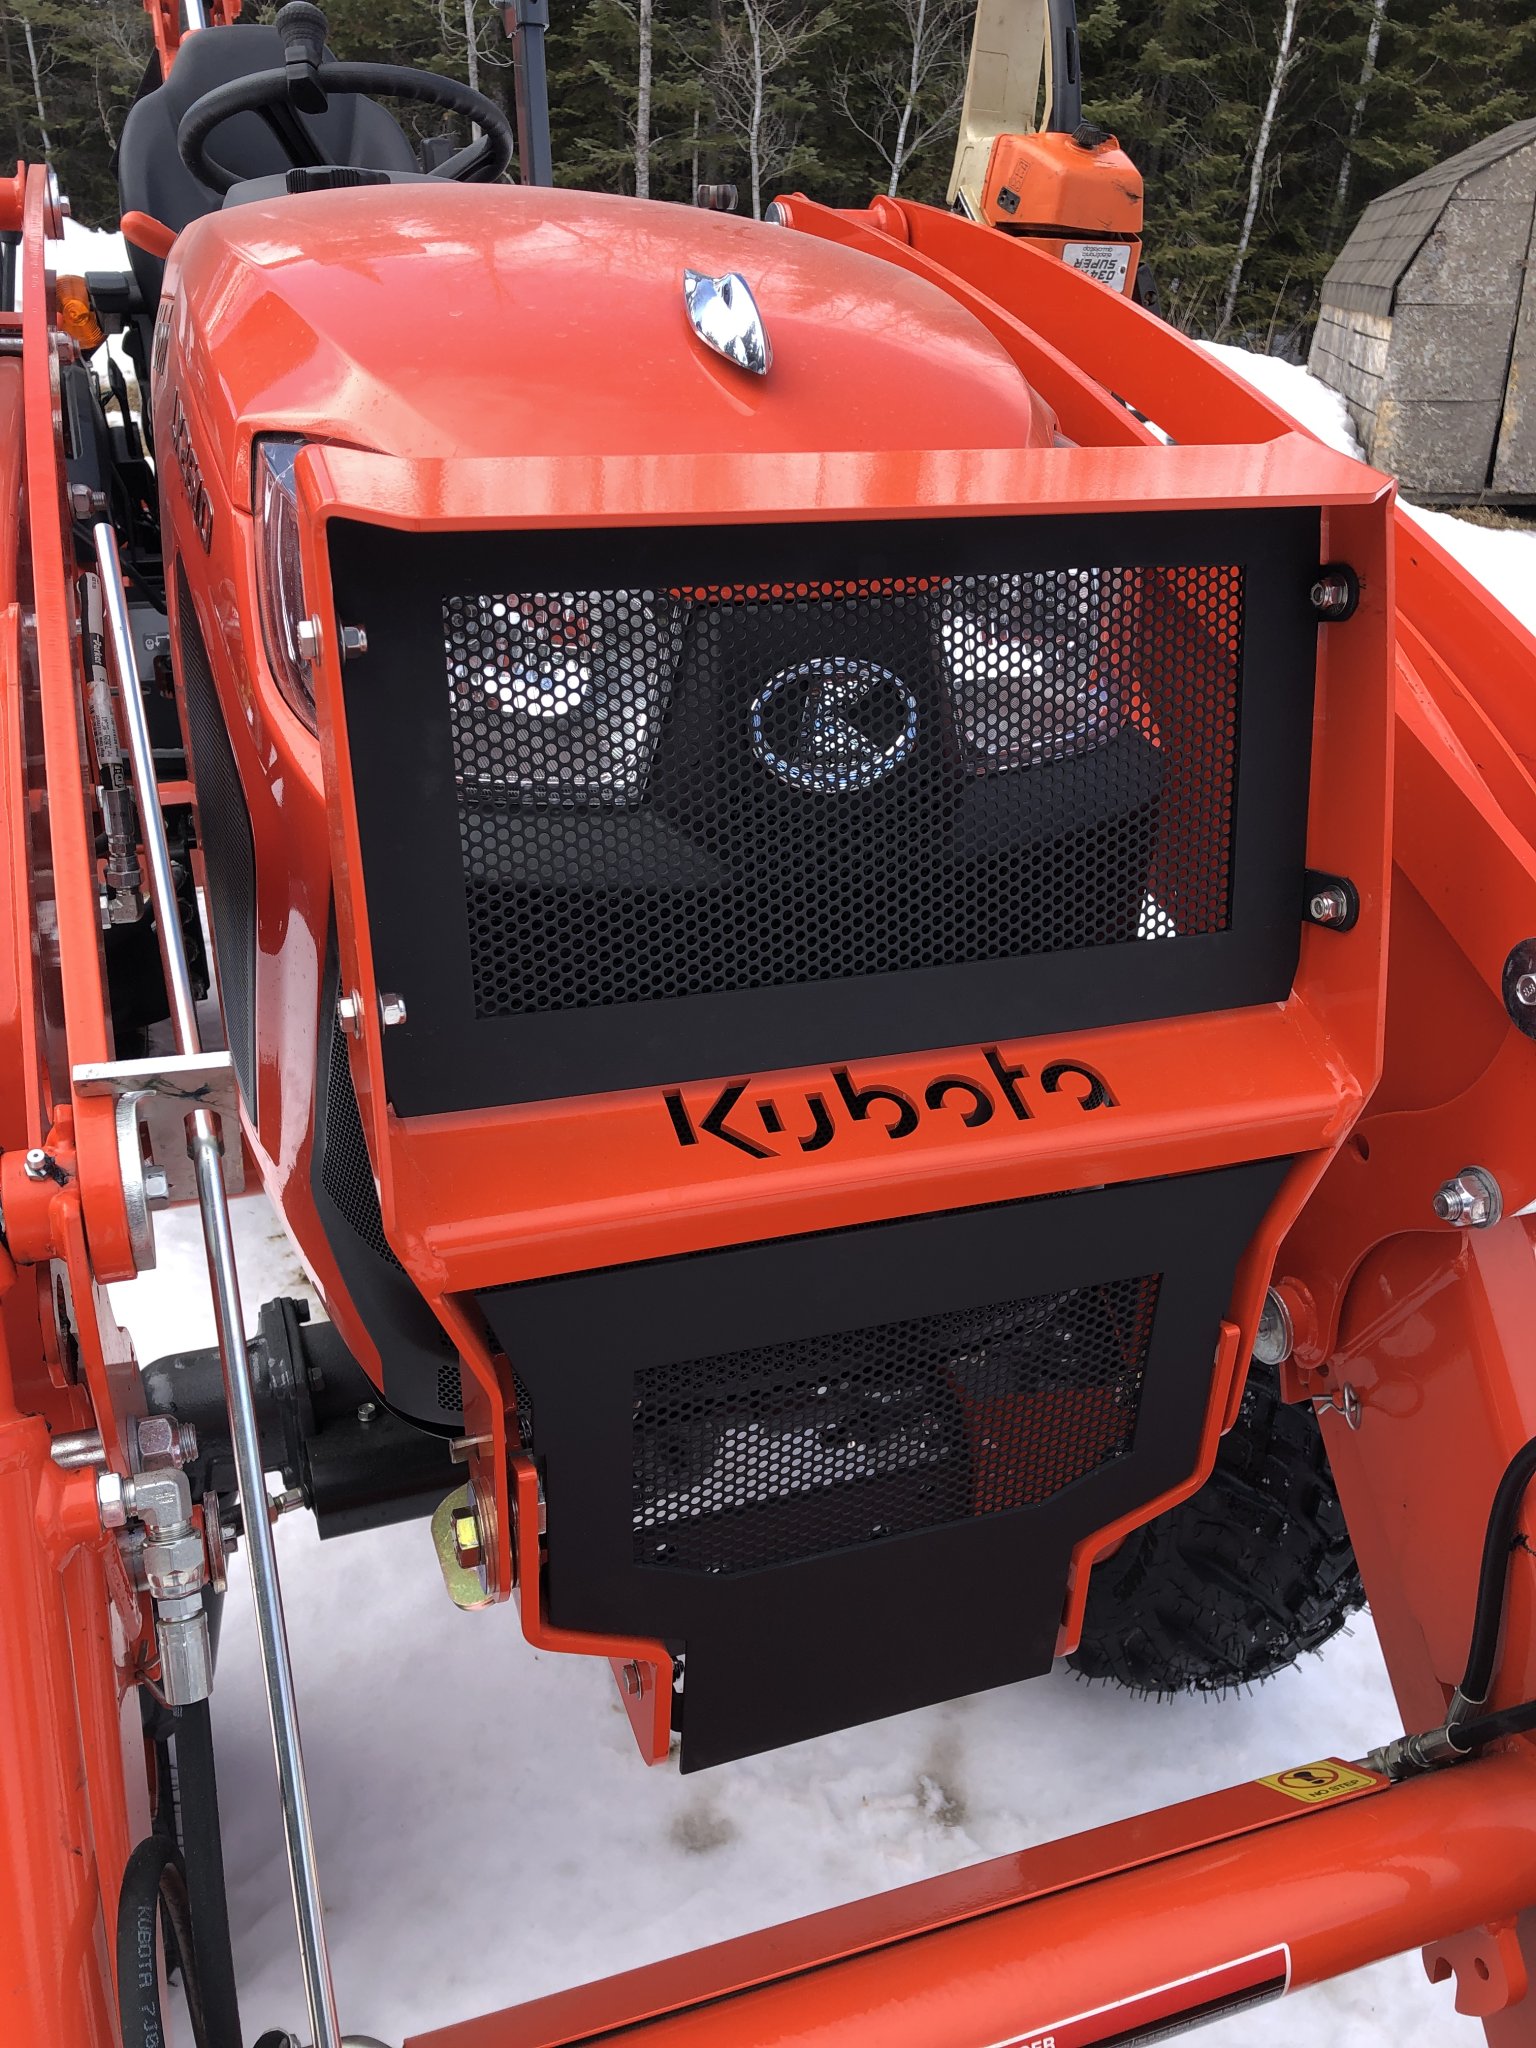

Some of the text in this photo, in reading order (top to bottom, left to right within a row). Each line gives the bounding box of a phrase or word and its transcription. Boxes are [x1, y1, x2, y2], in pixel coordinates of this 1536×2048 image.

[1074, 258, 1118, 270] SUPER
[662, 1046, 1120, 1159] Kubota
[1309, 1779, 1360, 1798] NO STEP
[138, 1906, 153, 1988] KUBOTA
